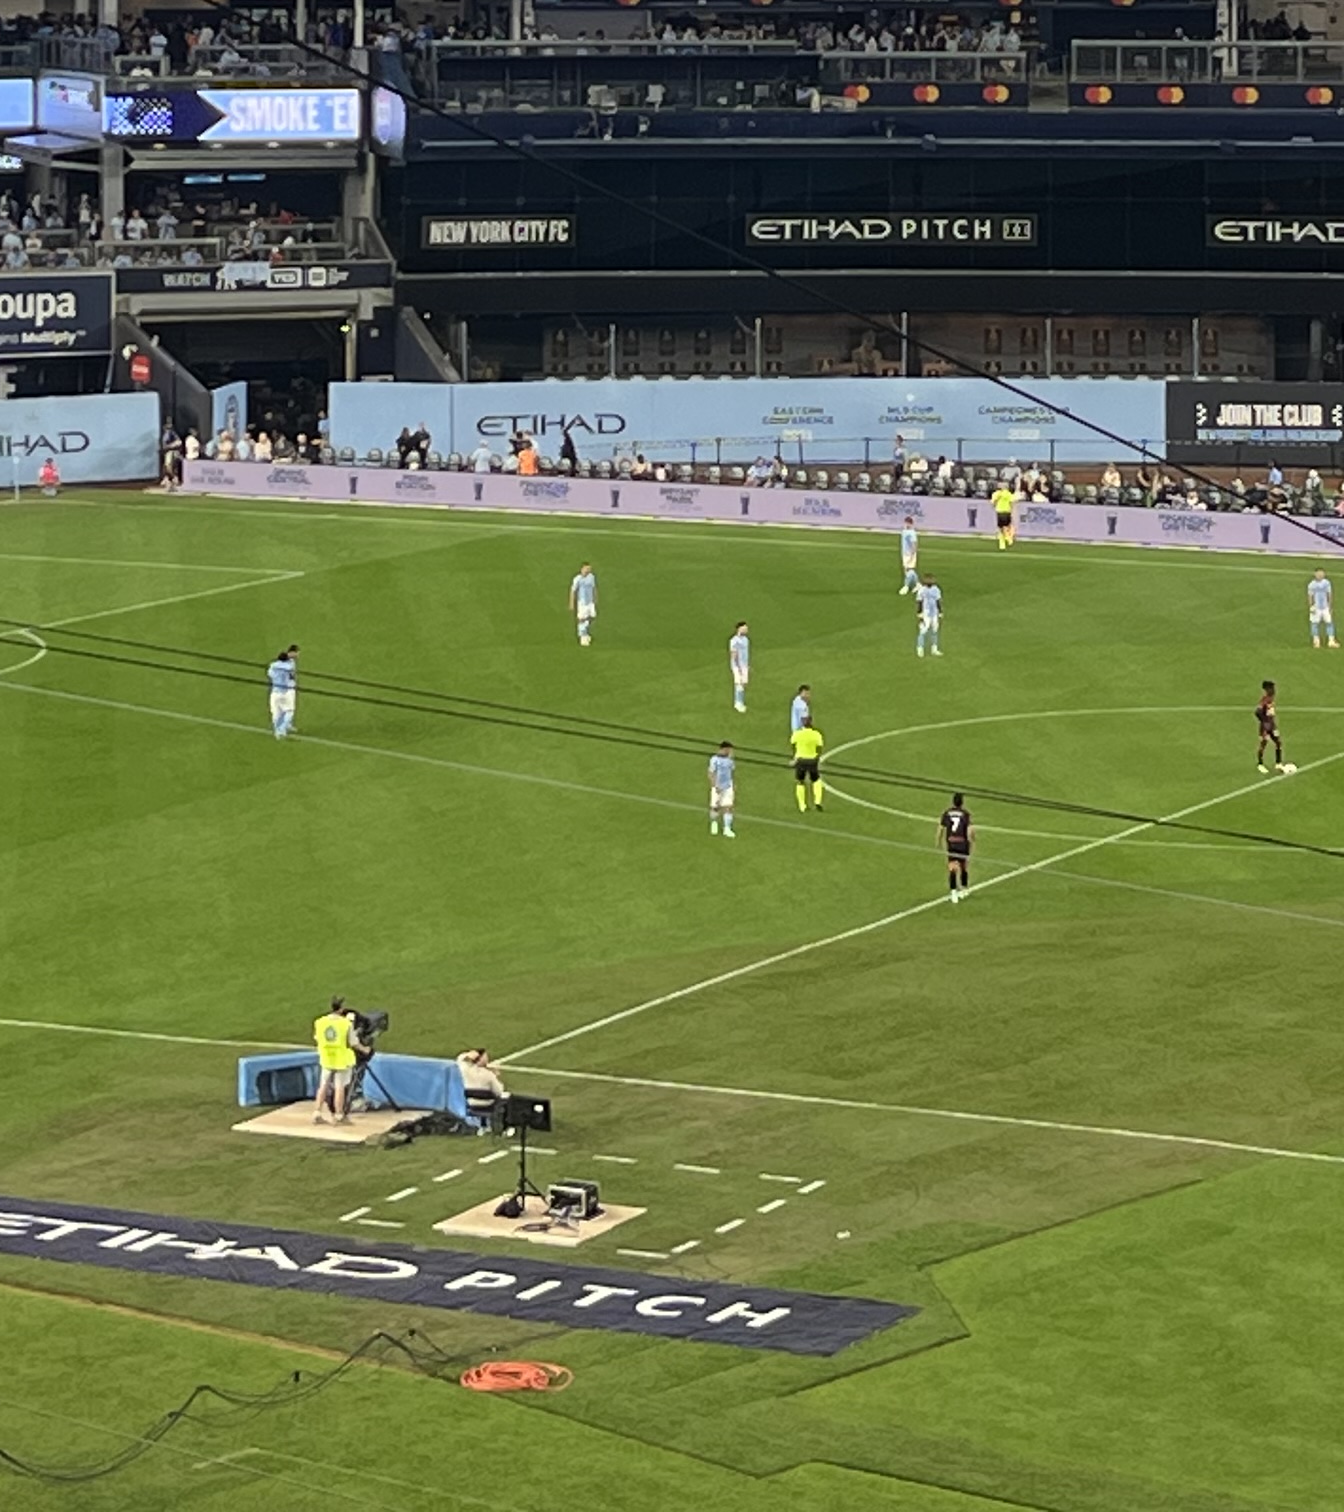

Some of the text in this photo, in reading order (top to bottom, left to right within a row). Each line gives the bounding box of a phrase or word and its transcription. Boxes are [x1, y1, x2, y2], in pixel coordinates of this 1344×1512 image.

[229, 95, 320, 132] SMOKE
[429, 220, 569, 244] NEW YORK CITY FC
[751, 219, 992, 240] ETIHAD PITCH
[476, 413, 626, 436] ETIHAD
[1216, 404, 1323, 426] JOIN THE CLUB
[444, 1269, 793, 1331] PITCH
